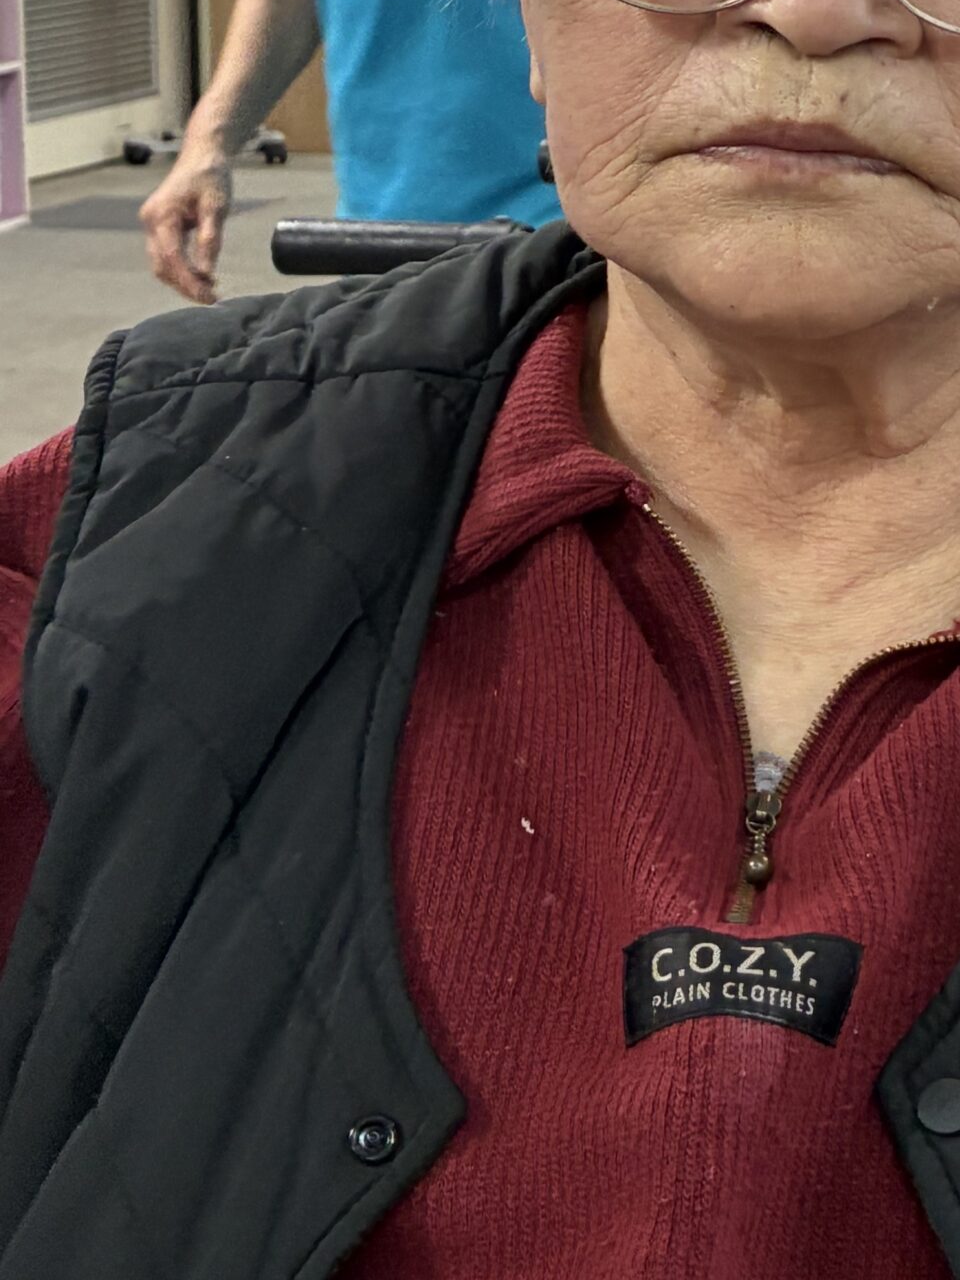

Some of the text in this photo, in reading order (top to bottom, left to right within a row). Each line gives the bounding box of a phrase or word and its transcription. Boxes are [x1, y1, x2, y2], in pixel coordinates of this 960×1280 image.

[651, 942, 818, 988] C.O.Z.Y.
[652, 981, 816, 1016] PLAIN CLOTHES
